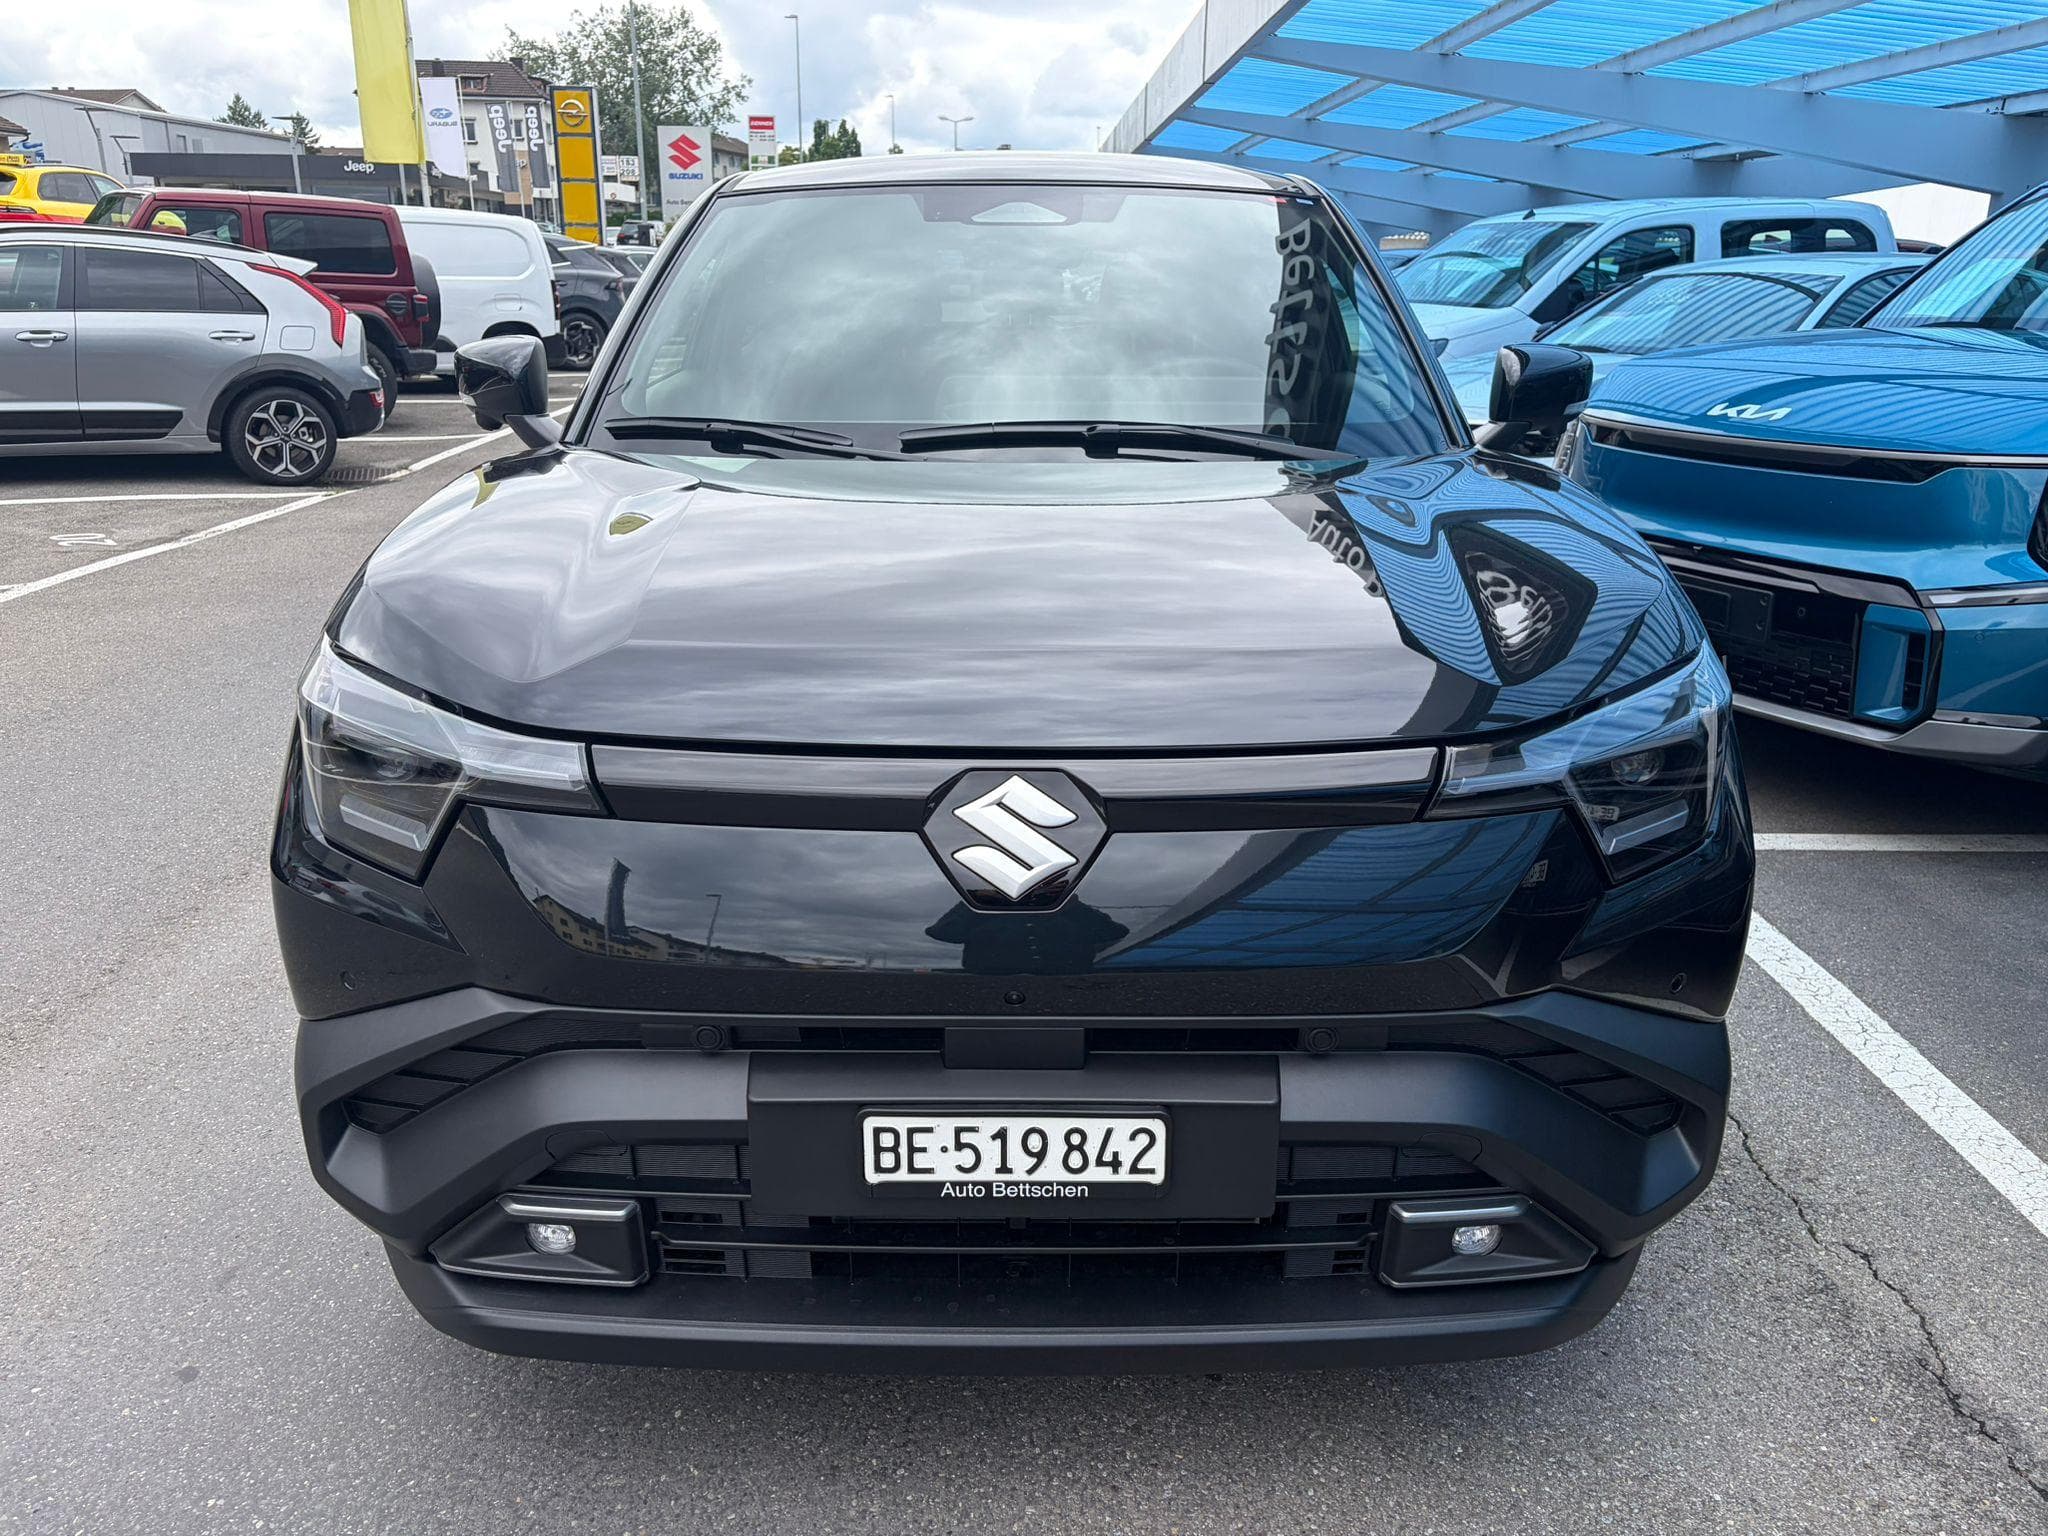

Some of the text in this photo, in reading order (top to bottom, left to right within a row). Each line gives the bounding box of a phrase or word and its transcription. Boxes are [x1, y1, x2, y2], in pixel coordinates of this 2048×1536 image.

[344, 160, 375, 174] Jeep
[940, 1182, 1089, 1198] Auto Bettschen
